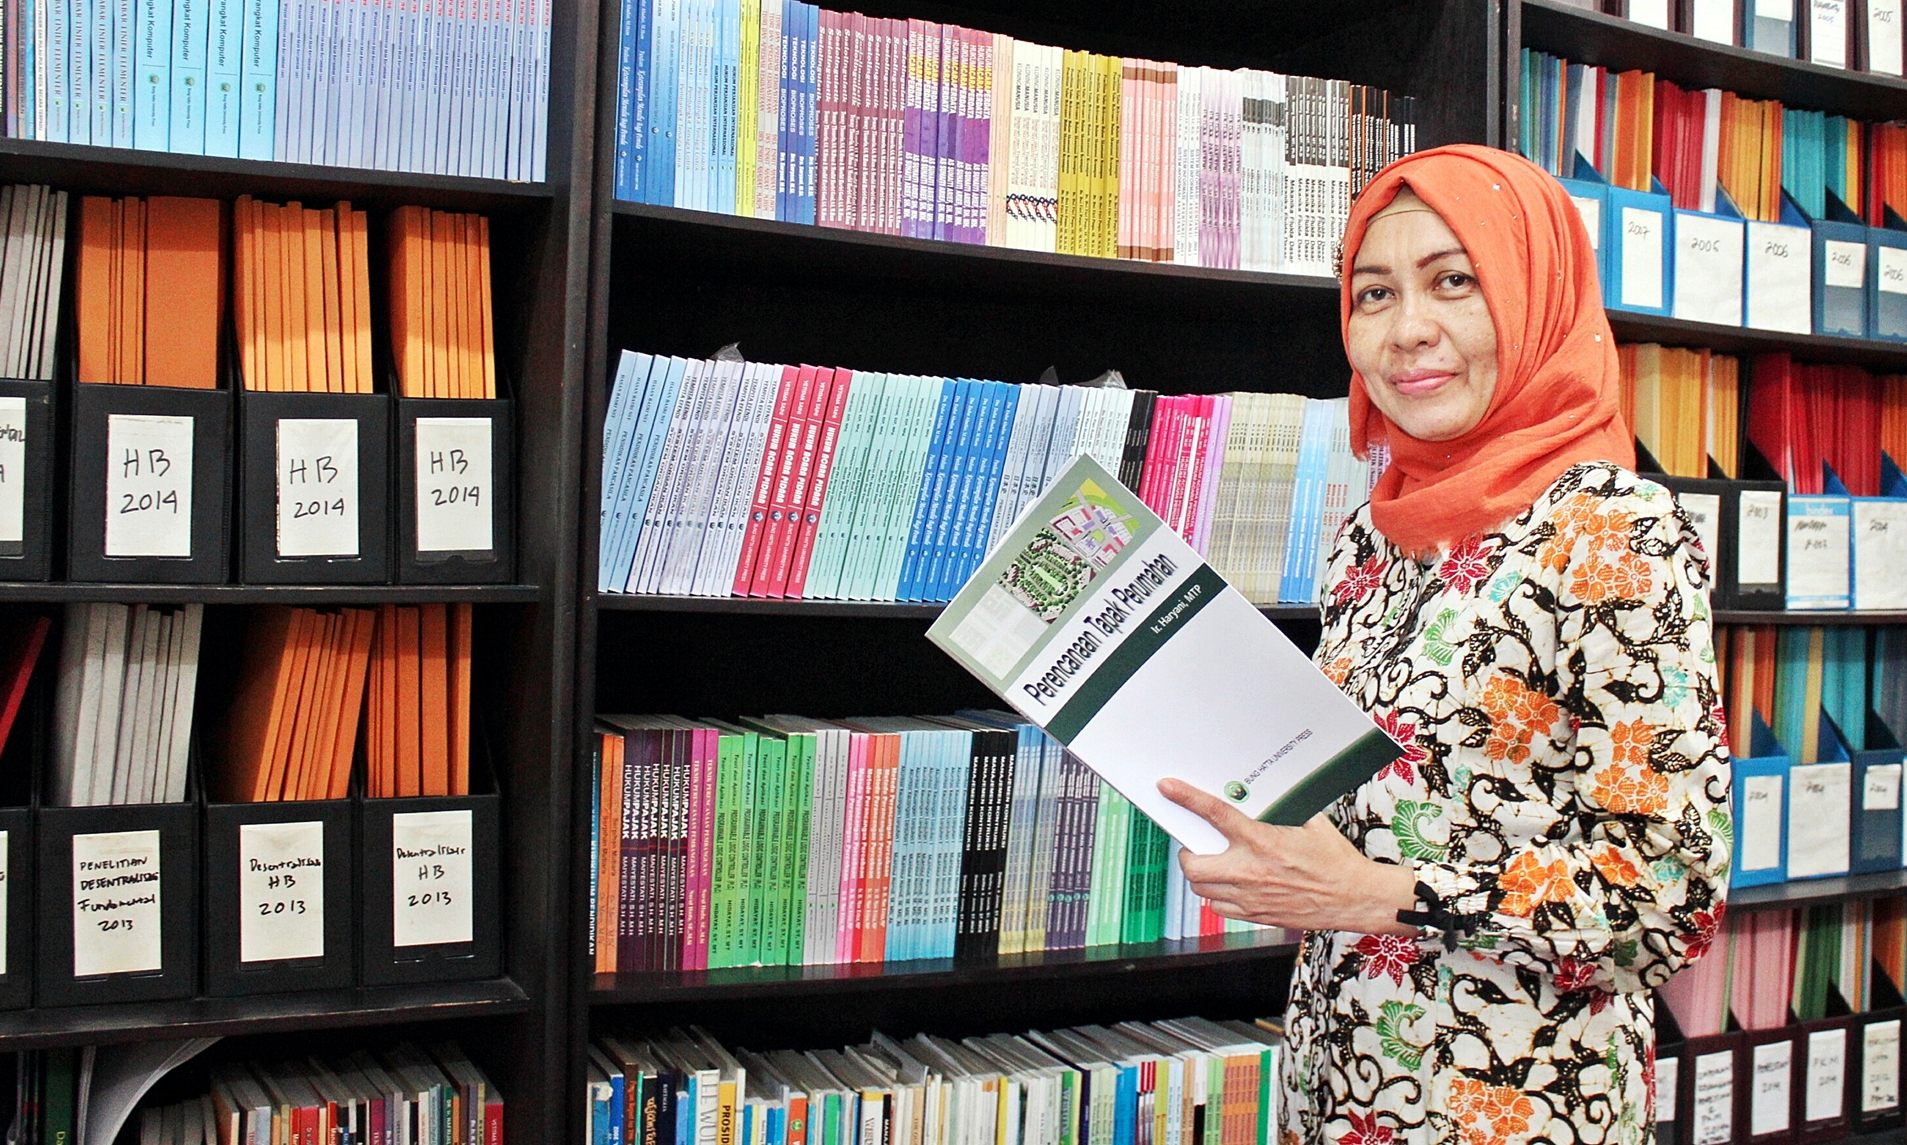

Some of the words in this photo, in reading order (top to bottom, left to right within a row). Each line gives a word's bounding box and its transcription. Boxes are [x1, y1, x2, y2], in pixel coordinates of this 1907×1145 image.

[146, 20, 155, 58] Komputer
[182, 23, 191, 61] Komputer
[217, 30, 227, 67] Komputer
[252, 30, 262, 67] Komputer
[833, 29, 841, 102] Sosiolinguistik
[865, 34, 873, 108] Sosiolinguistik
[891, 37, 900, 110] Sosiolinguistik
[1766, 241, 1788, 258] 2006
[770, 424, 783, 450] HUKUM
[788, 423, 801, 449] HUKUM
[804, 425, 817, 450] HUKUM
[824, 427, 836, 452] HUKUM
[647, 435, 661, 468] PENDIDIKAN
[764, 451, 777, 476] ACARA
[782, 450, 795, 475] ACARA
[798, 451, 812, 476] ACARA
[817, 453, 830, 479] ACARA
[433, 486, 480, 506] 2014
[638, 470, 652, 502] PANCASILA
[757, 477, 771, 504] PIDANA
[776, 476, 790, 503] PIDANA
[793, 477, 807, 505] PIDANA
[811, 479, 826, 507] PIDANA
[120, 490, 178, 514] 2014
[293, 498, 345, 518] 2014
[670, 495, 679, 514] IKAN
[1158, 600, 1189, 629] Haryani,
[1187, 585, 1203, 604] MTP
[1023, 630, 1103, 706] Perencanaan
[1083, 598, 1131, 635] Tapak
[1112, 553, 1178, 611] Perumahan
[1244, 771, 1260, 786] BUNG
[1258, 758, 1275, 775] HATTA
[1272, 739, 1299, 764] UNIVERSITY
[1295, 729, 1314, 744] PRESS
[970, 757, 979, 804] MANAJEMEN
[997, 756, 1006, 804] MANAJEMEN
[1005, 755, 1015, 802] MANAJEMEN
[861, 796, 871, 840] Perancangan
[966, 806, 974, 850] KONTRUKSI
[993, 806, 1001, 850] KONTRUKSI
[1002, 804, 1010, 848] KONTRUKSI
[80, 856, 148, 871] PENELITIAN
[860, 842, 868, 878] Percobaan
[259, 900, 306, 916] 2013
[407, 891, 452, 907] 2013
[98, 919, 134, 932] 2013
